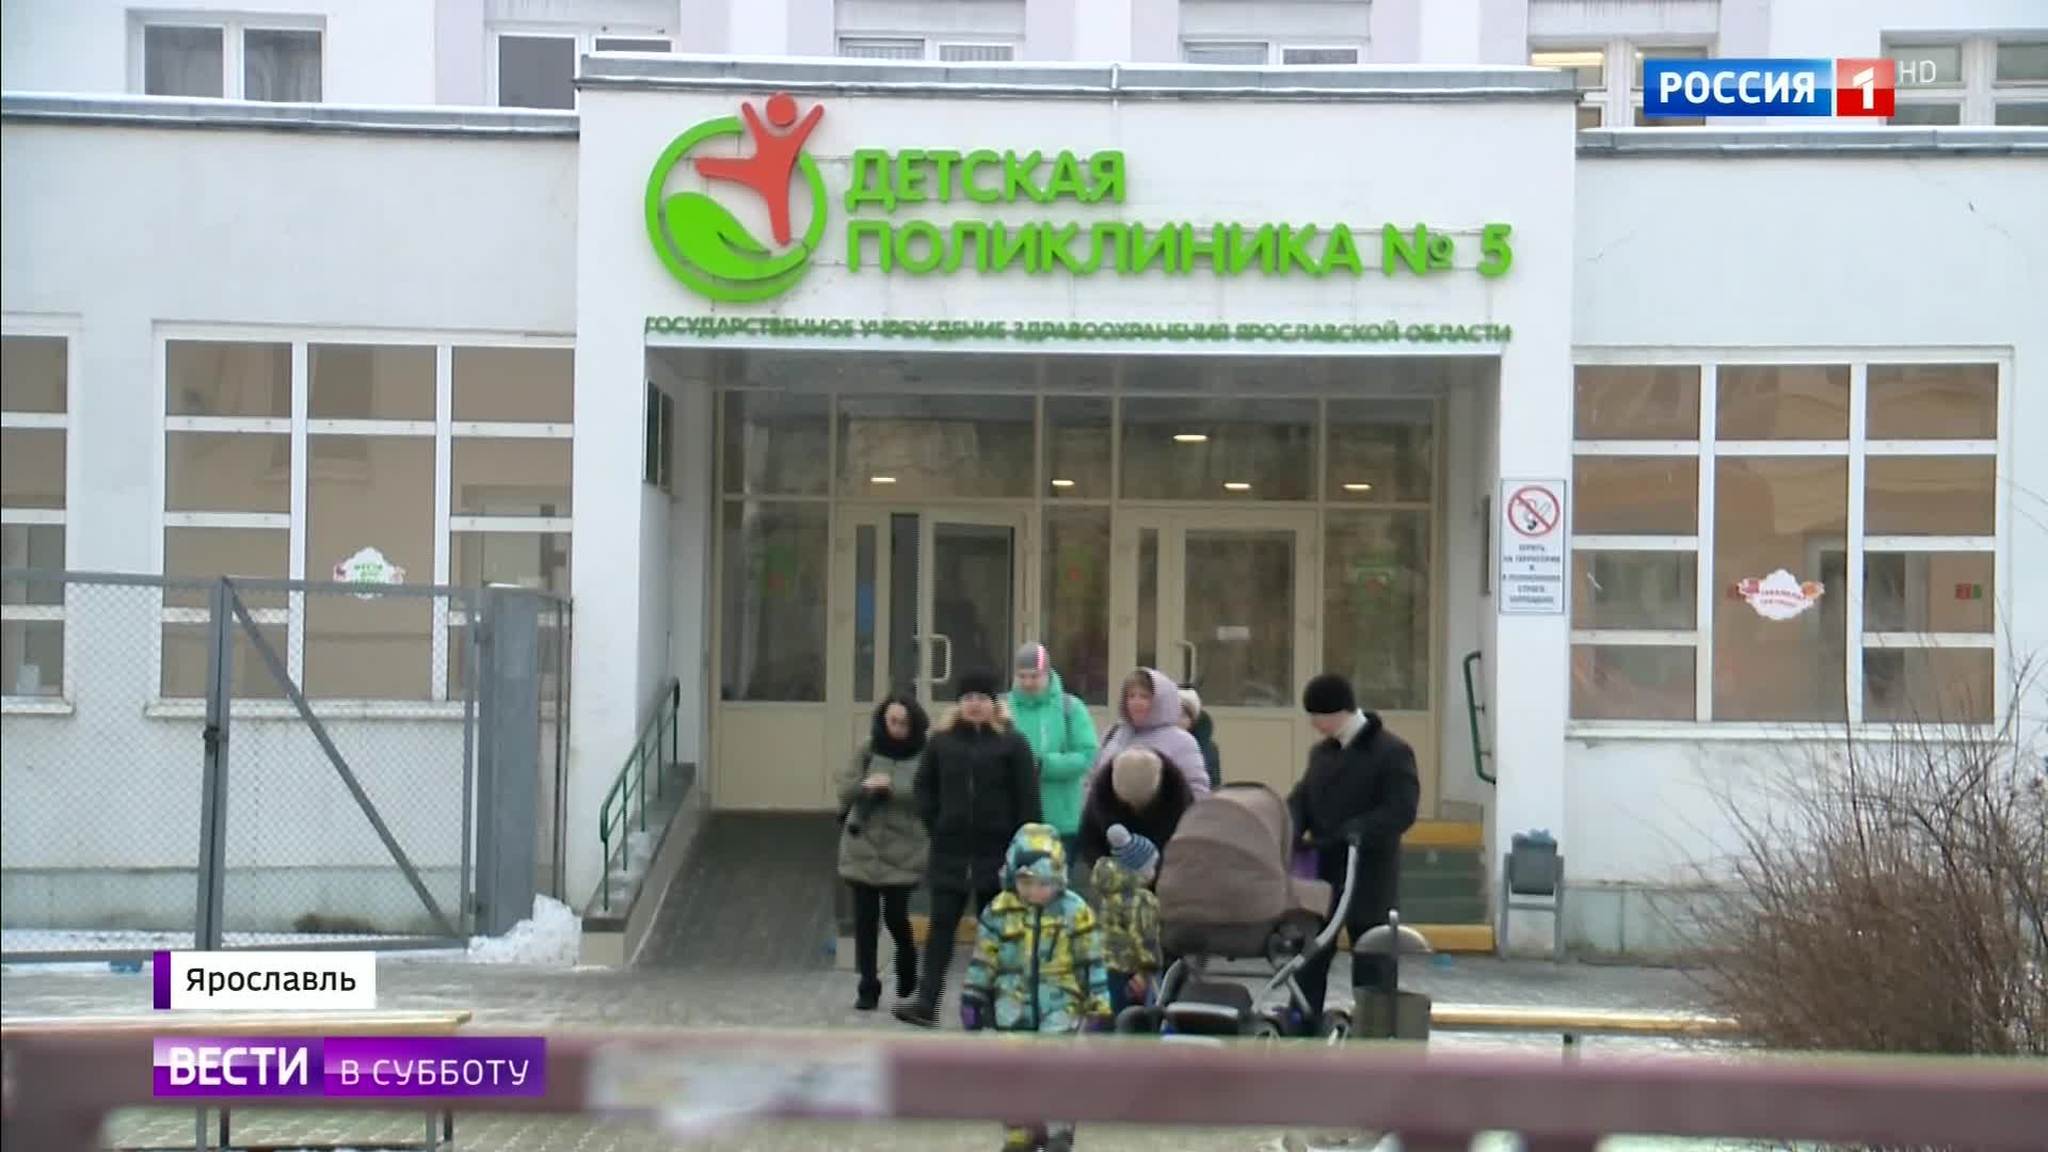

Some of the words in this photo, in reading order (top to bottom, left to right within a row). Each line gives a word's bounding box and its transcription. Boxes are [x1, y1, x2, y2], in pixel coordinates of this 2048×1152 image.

[845, 149, 1126, 211] ДЕТСКАЯ
[847, 219, 1364, 277] ПОЛИКЛИНИКА
[1382, 223, 1454, 276] №
[1478, 223, 1514, 279] 5
[645, 316, 856, 337] ГОСУДАРСТВЕННОЕ
[861, 319, 1005, 341] УЧРЕЖДЕНИЕ
[1014, 321, 1230, 343] ЗДРАВООХРАНЕНИЯ
[1234, 319, 1400, 343] ЯРОСЛАВСКОЙ
[1405, 323, 1513, 344] ОБЛАСТИ
